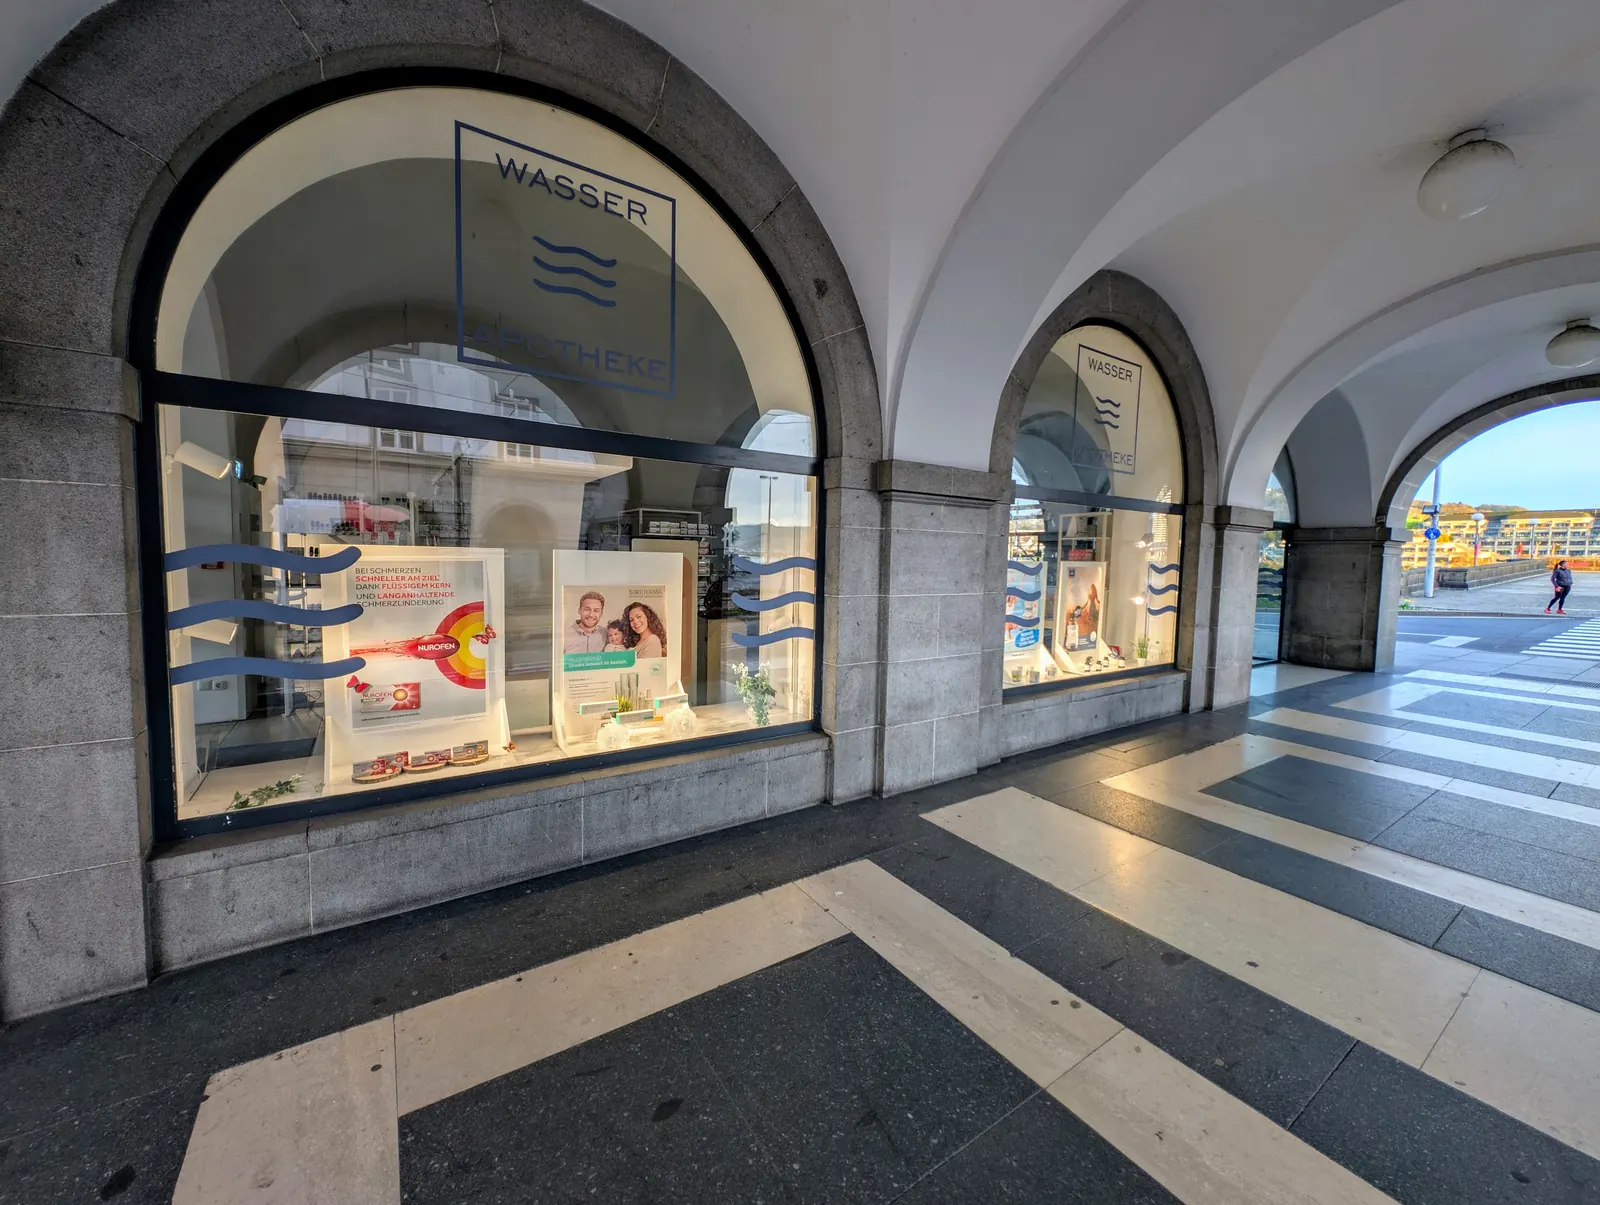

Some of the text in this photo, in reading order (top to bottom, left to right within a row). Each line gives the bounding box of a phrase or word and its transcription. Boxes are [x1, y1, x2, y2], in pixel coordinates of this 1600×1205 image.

[495, 152, 648, 225] WASSER
[472, 324, 668, 383] APOTHEKE
[1088, 356, 1133, 382] WASSER
[1074, 445, 1134, 467] OTHEKE
[377, 591, 455, 600] LANGANHALTENDE
[381, 582, 429, 590] FLÜSSIGEM
[417, 642, 455, 652] NUROFEN
